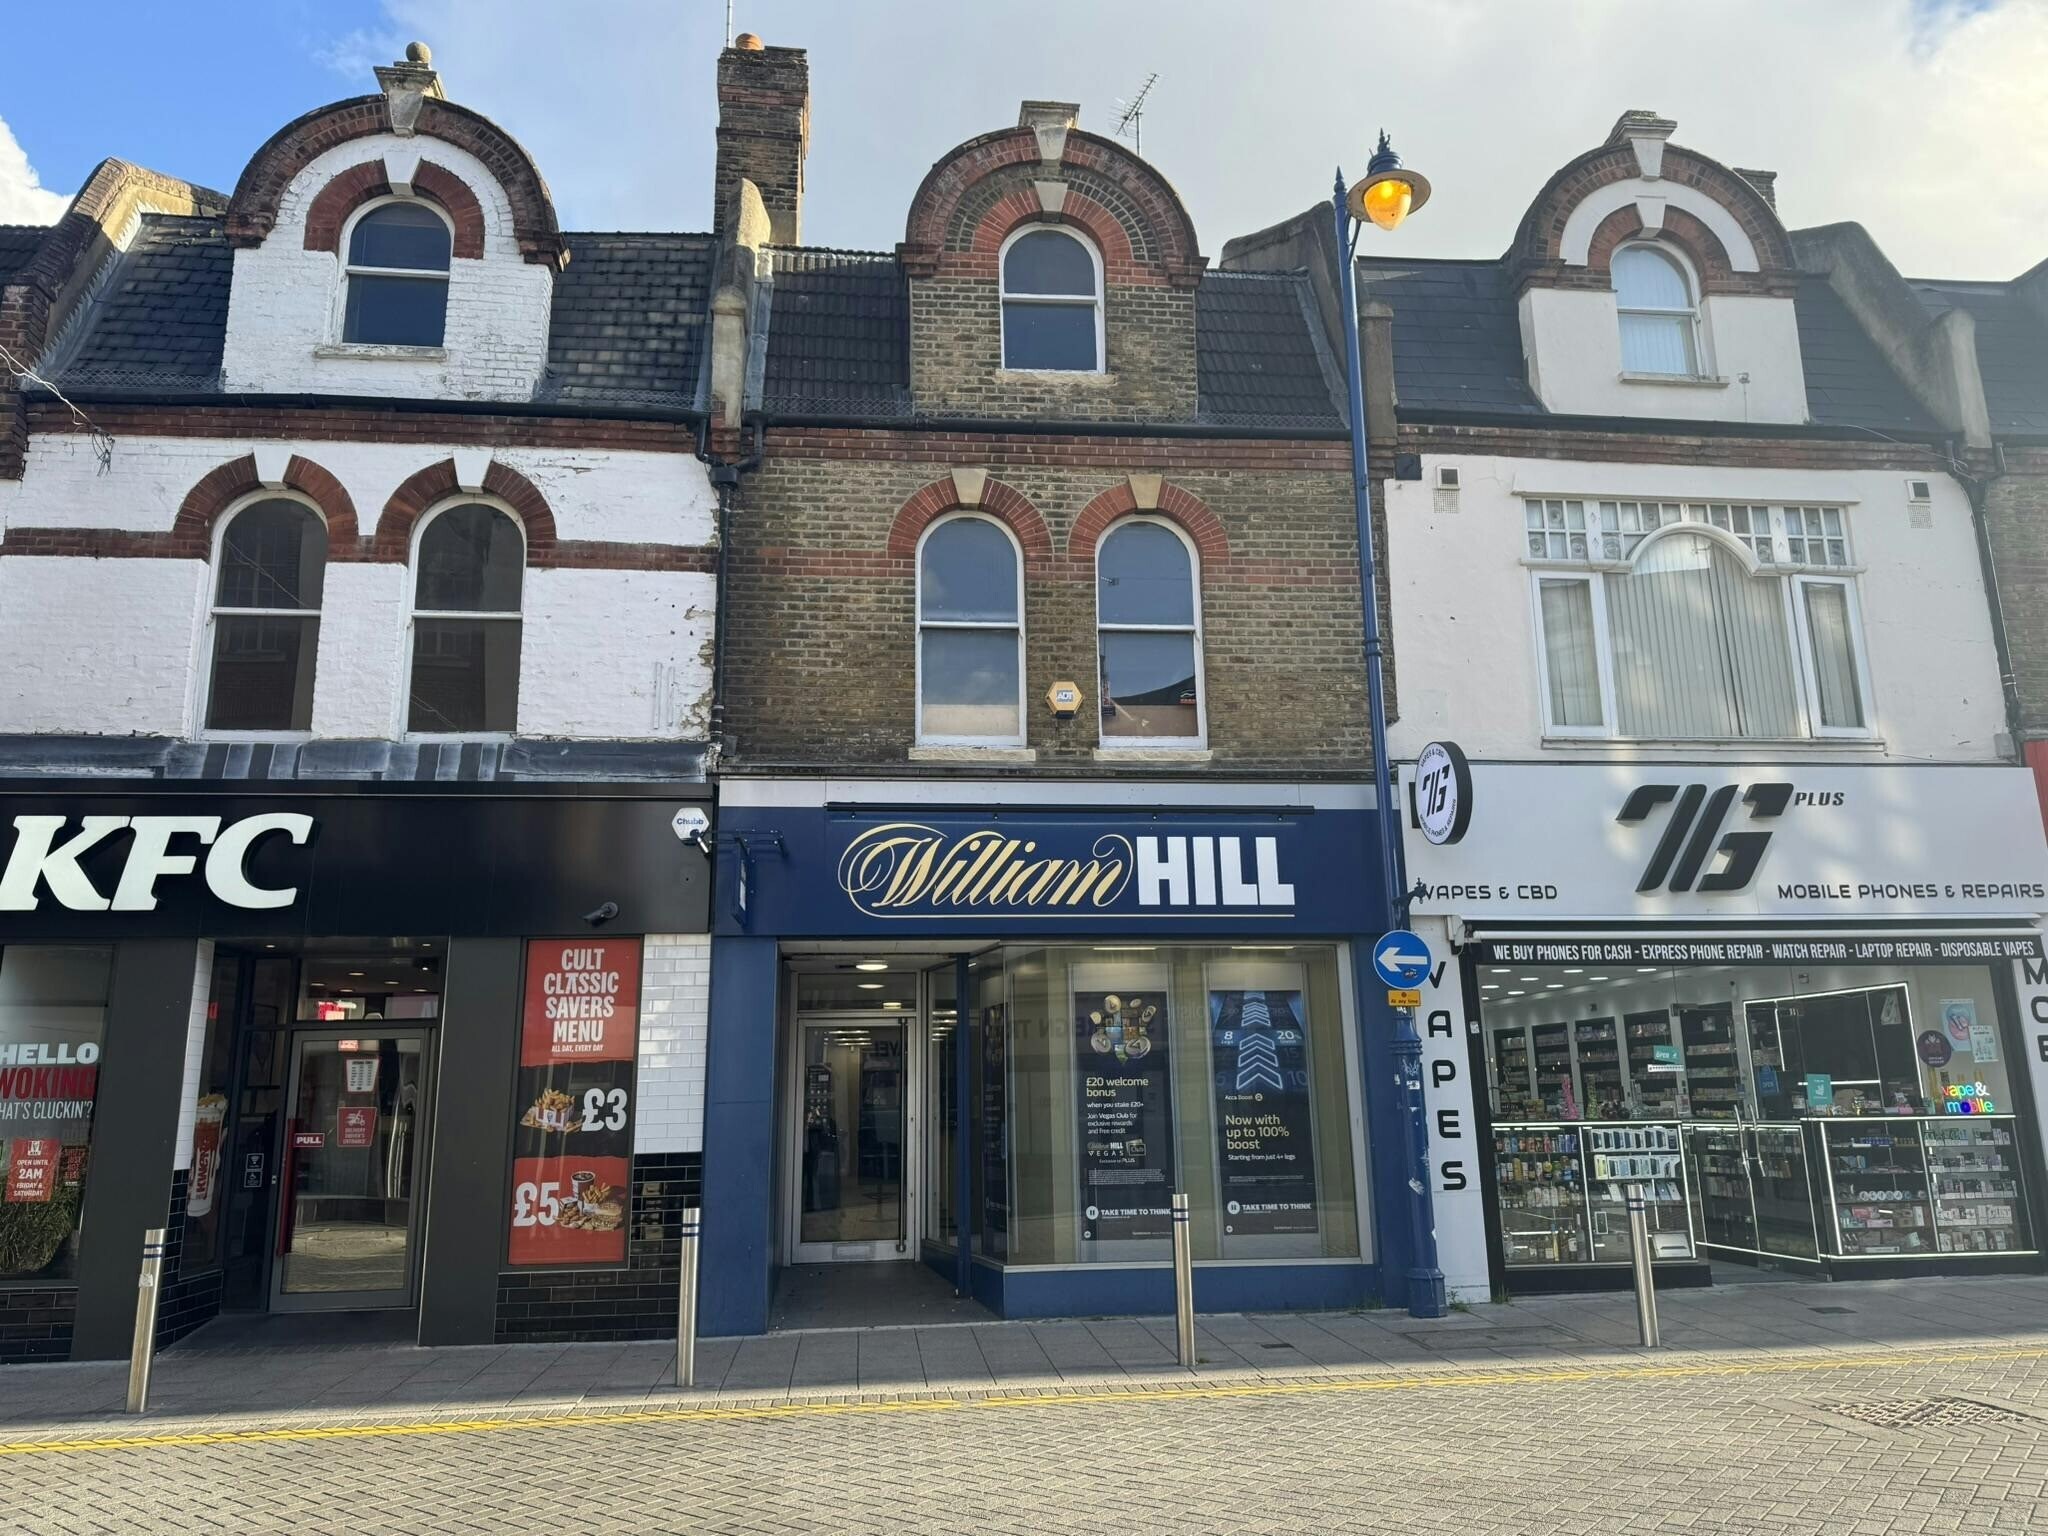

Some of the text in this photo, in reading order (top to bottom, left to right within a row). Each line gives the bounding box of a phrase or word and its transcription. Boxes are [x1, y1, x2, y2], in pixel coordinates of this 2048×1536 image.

[1794, 791, 1844, 806] PLUS
[0, 813, 313, 911] KFC
[838, 824, 1295, 907] William HILL
[1424, 885, 1557, 900] VAPES & CBD
[1778, 883, 2045, 899] MOBILE PHONES & REPAIRS
[1494, 945, 1511, 960] WE
[1513, 945, 1534, 960] BUY
[1536, 945, 1579, 961] PHONES
[1582, 945, 1602, 960] FOR
[1604, 945, 1632, 960] CASH
[1642, 944, 1688, 960] EXPRESS
[1690, 944, 1725, 959] PHONE
[1727, 944, 1763, 959] REPAIR
[1773, 944, 1808, 959] WATCH
[1810, 943, 1847, 959] REPAIR
[1856, 943, 1894, 958] LAPTOP
[1896, 943, 1932, 958] REPAIR
[1941, 942, 2002, 957] DISPOSABLE
[2004, 941, 2035, 956] VAPES
[561, 948, 605, 971] CULT
[543, 971, 619, 995] CLASSIC
[545, 995, 615, 1019] SAVERS
[552, 1020, 604, 1043] MENU
[1224, 1031, 1233, 1040] 8
[0, 1042, 99, 1065] HELLO
[575, 1044, 592, 1052] EVERY
[1086, 1077, 1149, 1086] £20 welcome
[1428, 960, 1467, 1191] VAPES
[1086, 1087, 1116, 1097] bonus
[1941, 1081, 1990, 1099] vape &
[0, 1100, 93, 1120] HAT'S CLUCKIN'?
[581, 1088, 628, 1131] £3
[1225, 1114, 1280, 1125] Now with
[296, 1136, 322, 1144] PULL
[1226, 1126, 1290, 1139] up to 100%
[1227, 1139, 1260, 1149] boost
[17, 1159, 33, 1167] OPEN
[1265, 1153, 1276, 1161] just
[18, 1168, 43, 1180] 2AM
[16, 1181, 37, 1189] FRIDAY
[14, 1189, 44, 1197] SATURDAY
[513, 1182, 560, 1227] £5
